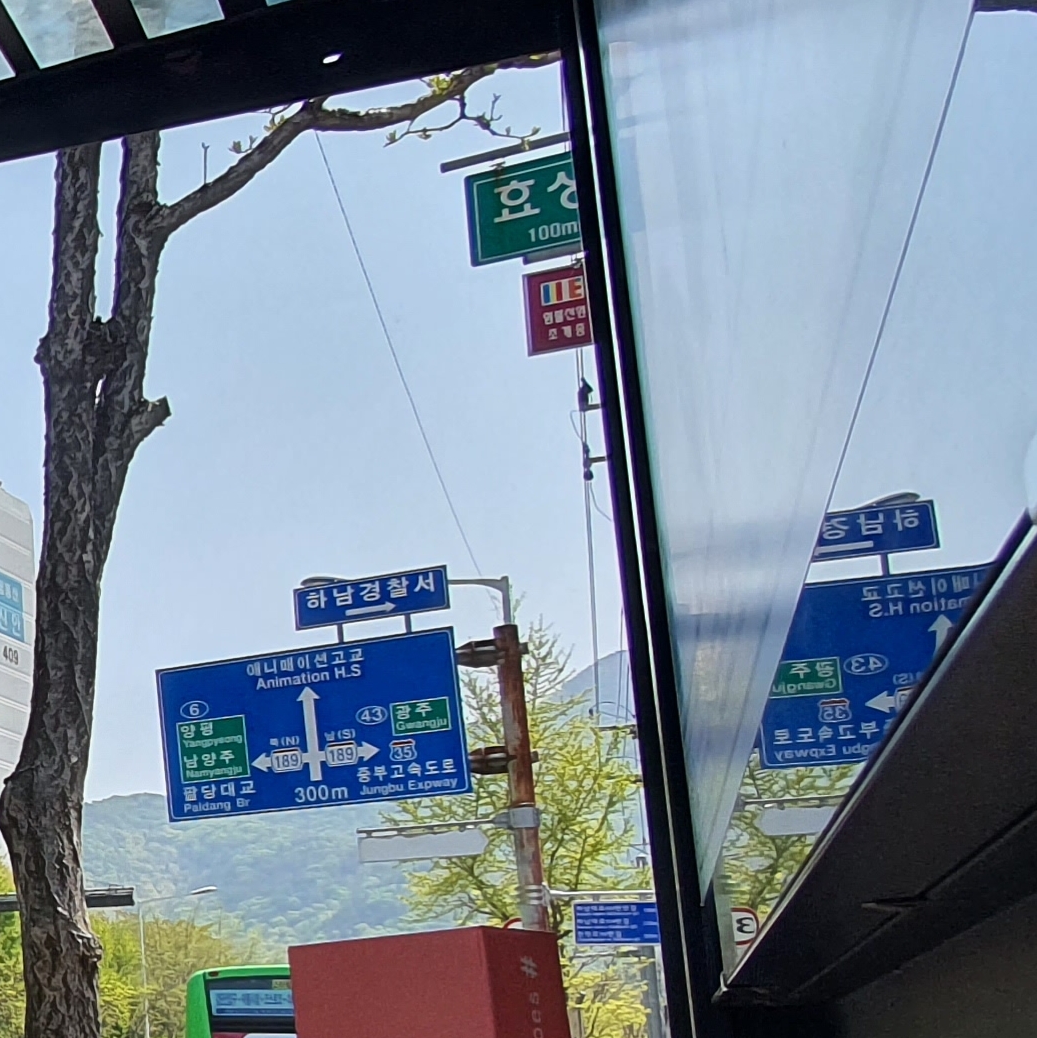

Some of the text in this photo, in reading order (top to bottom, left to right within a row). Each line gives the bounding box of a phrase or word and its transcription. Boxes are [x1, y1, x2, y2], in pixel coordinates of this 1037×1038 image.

[528, 221, 578, 242] 100m
[305, 571, 436, 610] 하남경찰서
[2, 645, 19, 665] 409
[256, 671, 330, 690] Animation
[189, 703, 200, 716] 6
[360, 708, 383, 722] 43
[395, 703, 432, 720] 광주
[180, 722, 213, 738] 양평
[396, 717, 447, 731] Gwangju
[182, 734, 243, 748] Yangpyeong
[183, 750, 235, 768] 남양주
[275, 753, 299, 768] 189
[329, 748, 354, 763] 189
[394, 746, 413, 760] 35
[186, 765, 243, 778] Namyangju
[356, 759, 457, 783] 중부고속도로
[183, 780, 257, 802] 팔당대교
[294, 785, 349, 803] 300m
[360, 778, 458, 796] Jungbu Expway
[183, 797, 251, 813] Paldang Br
